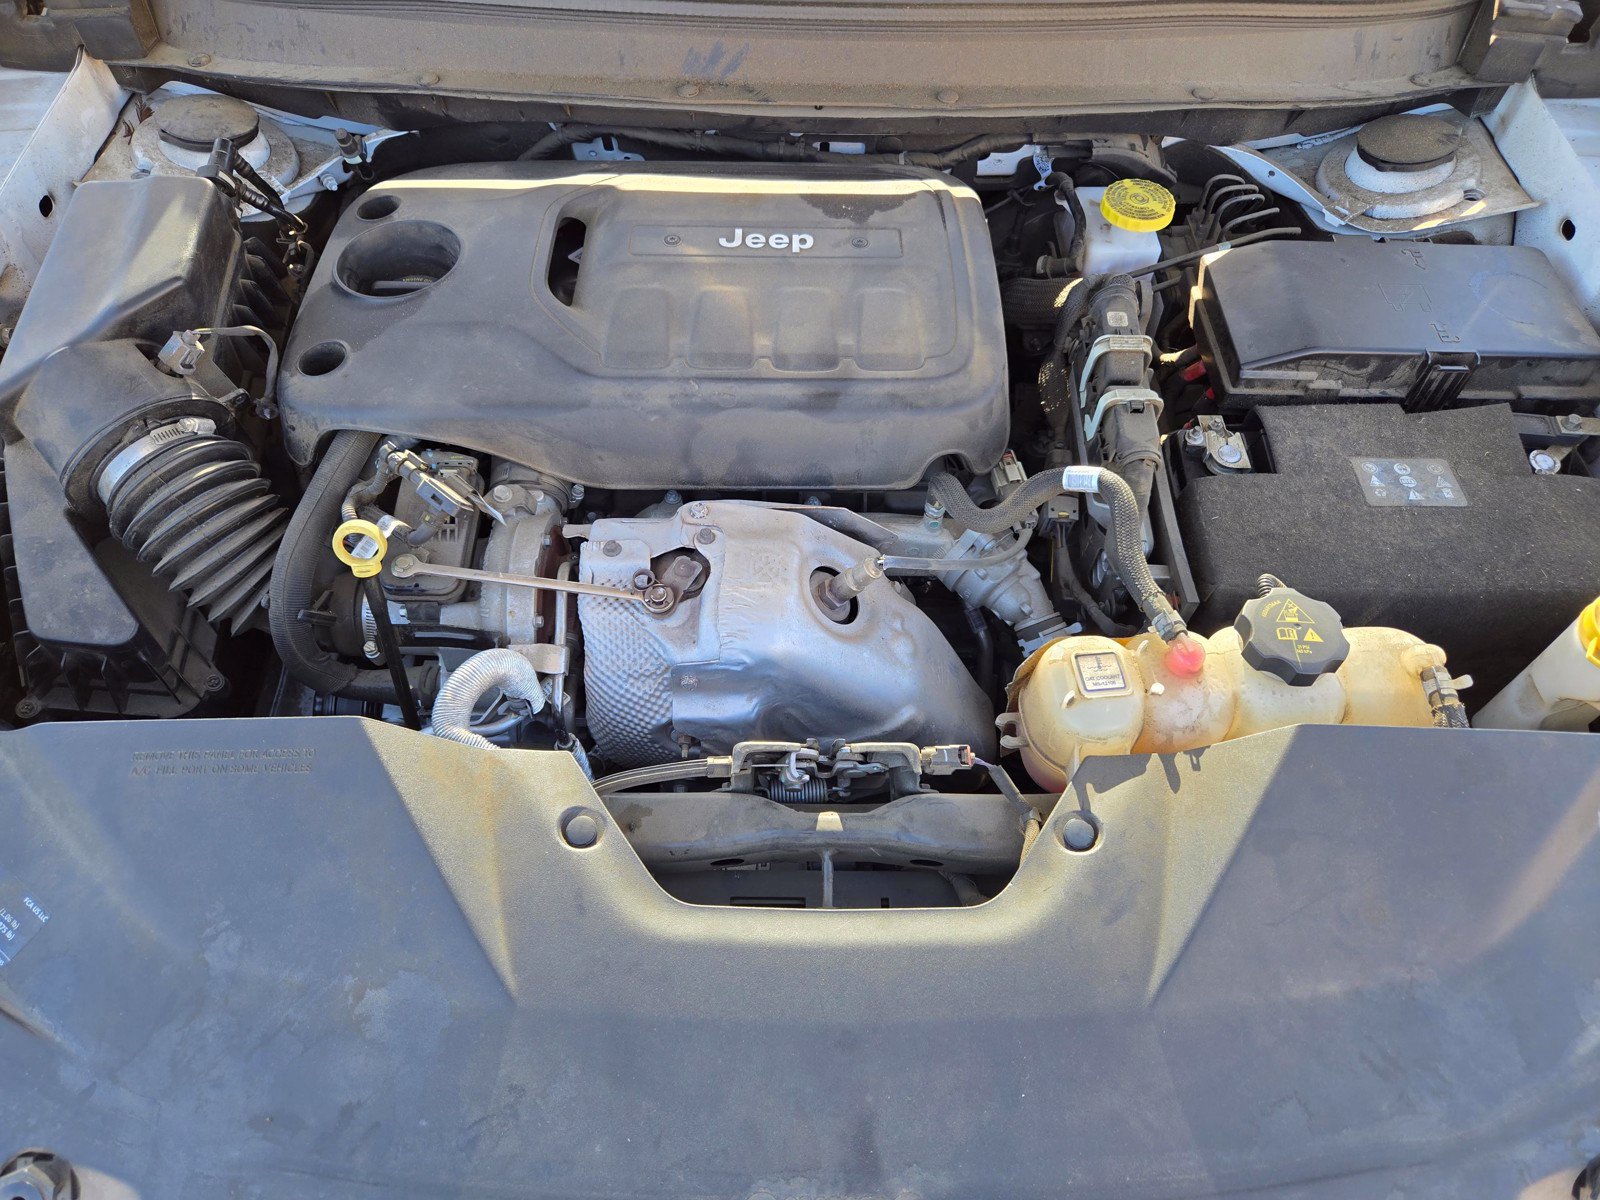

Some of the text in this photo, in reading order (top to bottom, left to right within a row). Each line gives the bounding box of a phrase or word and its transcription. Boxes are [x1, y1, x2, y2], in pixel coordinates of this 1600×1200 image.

[719, 228, 814, 252] Jeep
[131, 748, 316, 762] REMOVE THIS PANEL FOR ACCESS TO
[155, 766, 177, 776] FILL
[181, 765, 208, 776] PORT
[211, 765, 229, 775] ON
[229, 764, 258, 775] SOME
[263, 763, 313, 774] VEHICLES
[24, 897, 34, 909] FCA
[38, 911, 49, 922] LLC
